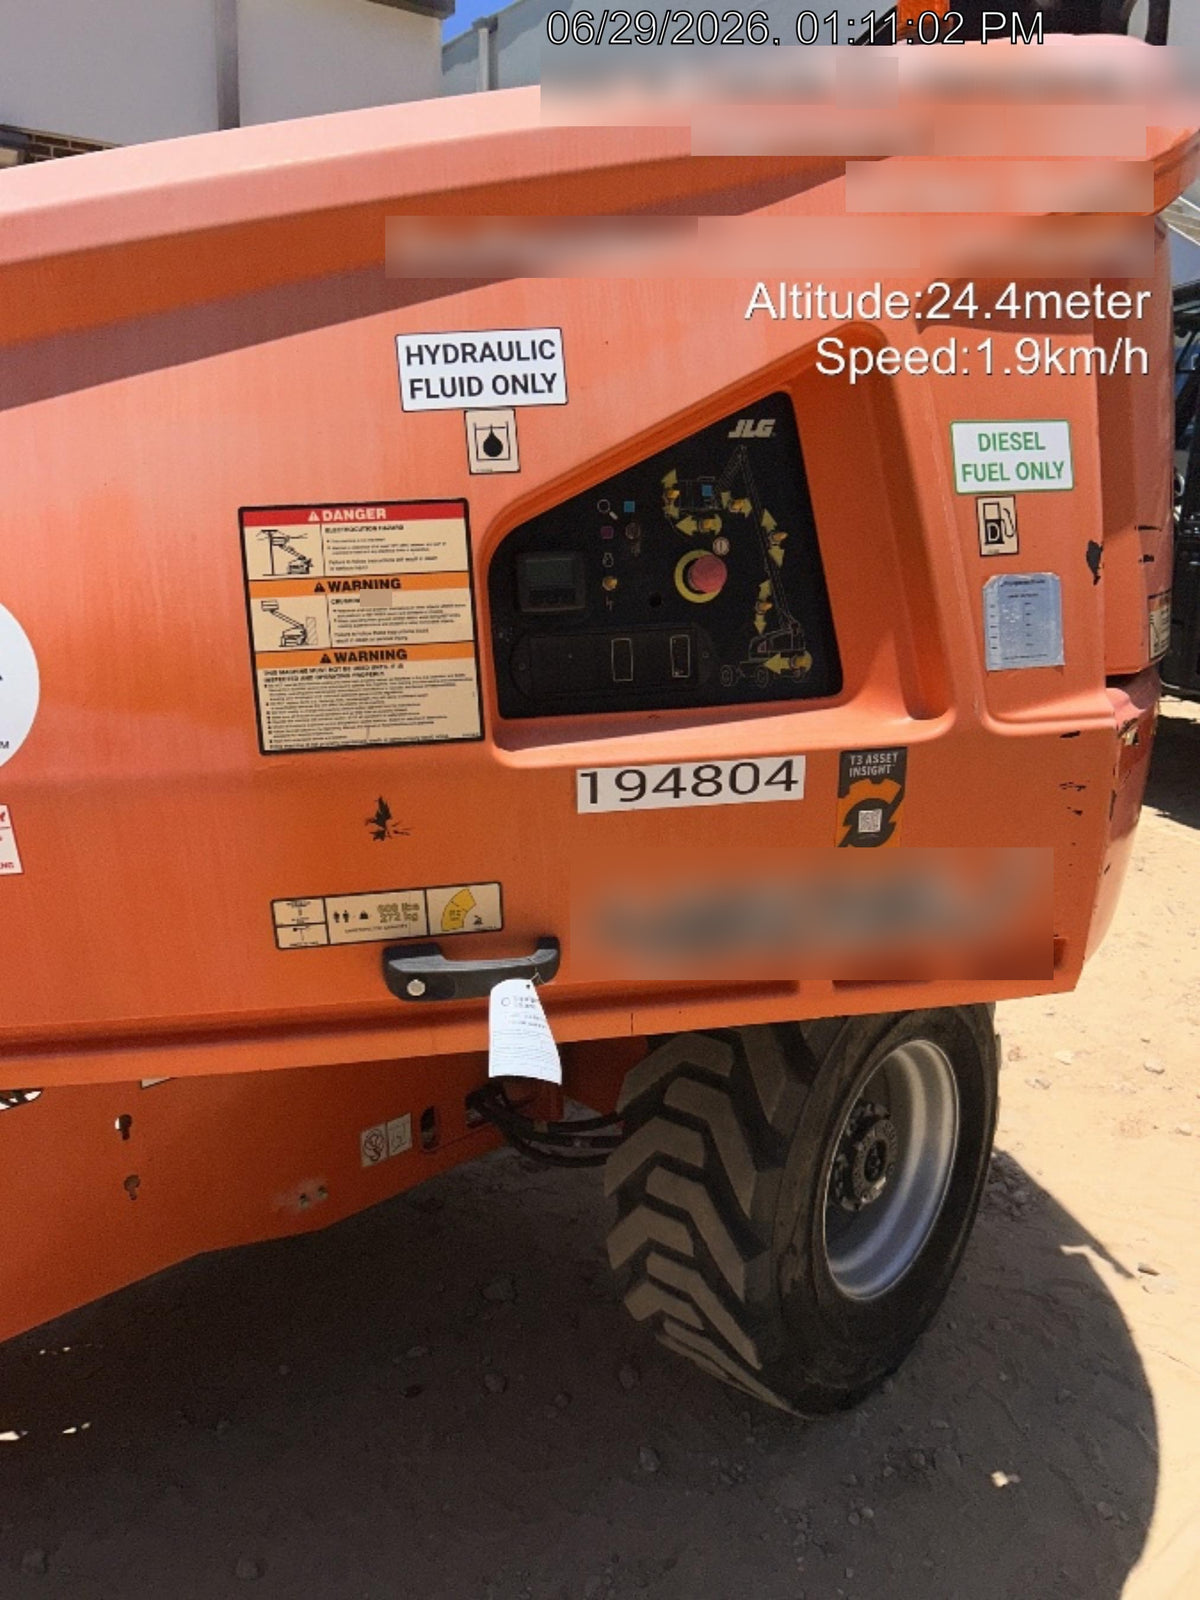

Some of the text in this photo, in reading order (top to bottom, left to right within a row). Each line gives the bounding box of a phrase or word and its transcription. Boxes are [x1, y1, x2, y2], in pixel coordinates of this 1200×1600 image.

[406, 339, 556, 366] HYDRAULIC
[410, 372, 558, 399] FLUID ONLY
[728, 419, 776, 438] JLG
[978, 431, 1046, 452] DIESEL
[961, 461, 1065, 482] FUEL ONLY
[322, 508, 387, 522] DANGER
[987, 522, 1000, 542] D
[327, 578, 401, 593] WARNING
[333, 649, 408, 663] WARNING
[850, 752, 898, 766] T3 ASSET
[849, 764, 891, 777] INSIGHT
[580, 759, 799, 804] 194804
